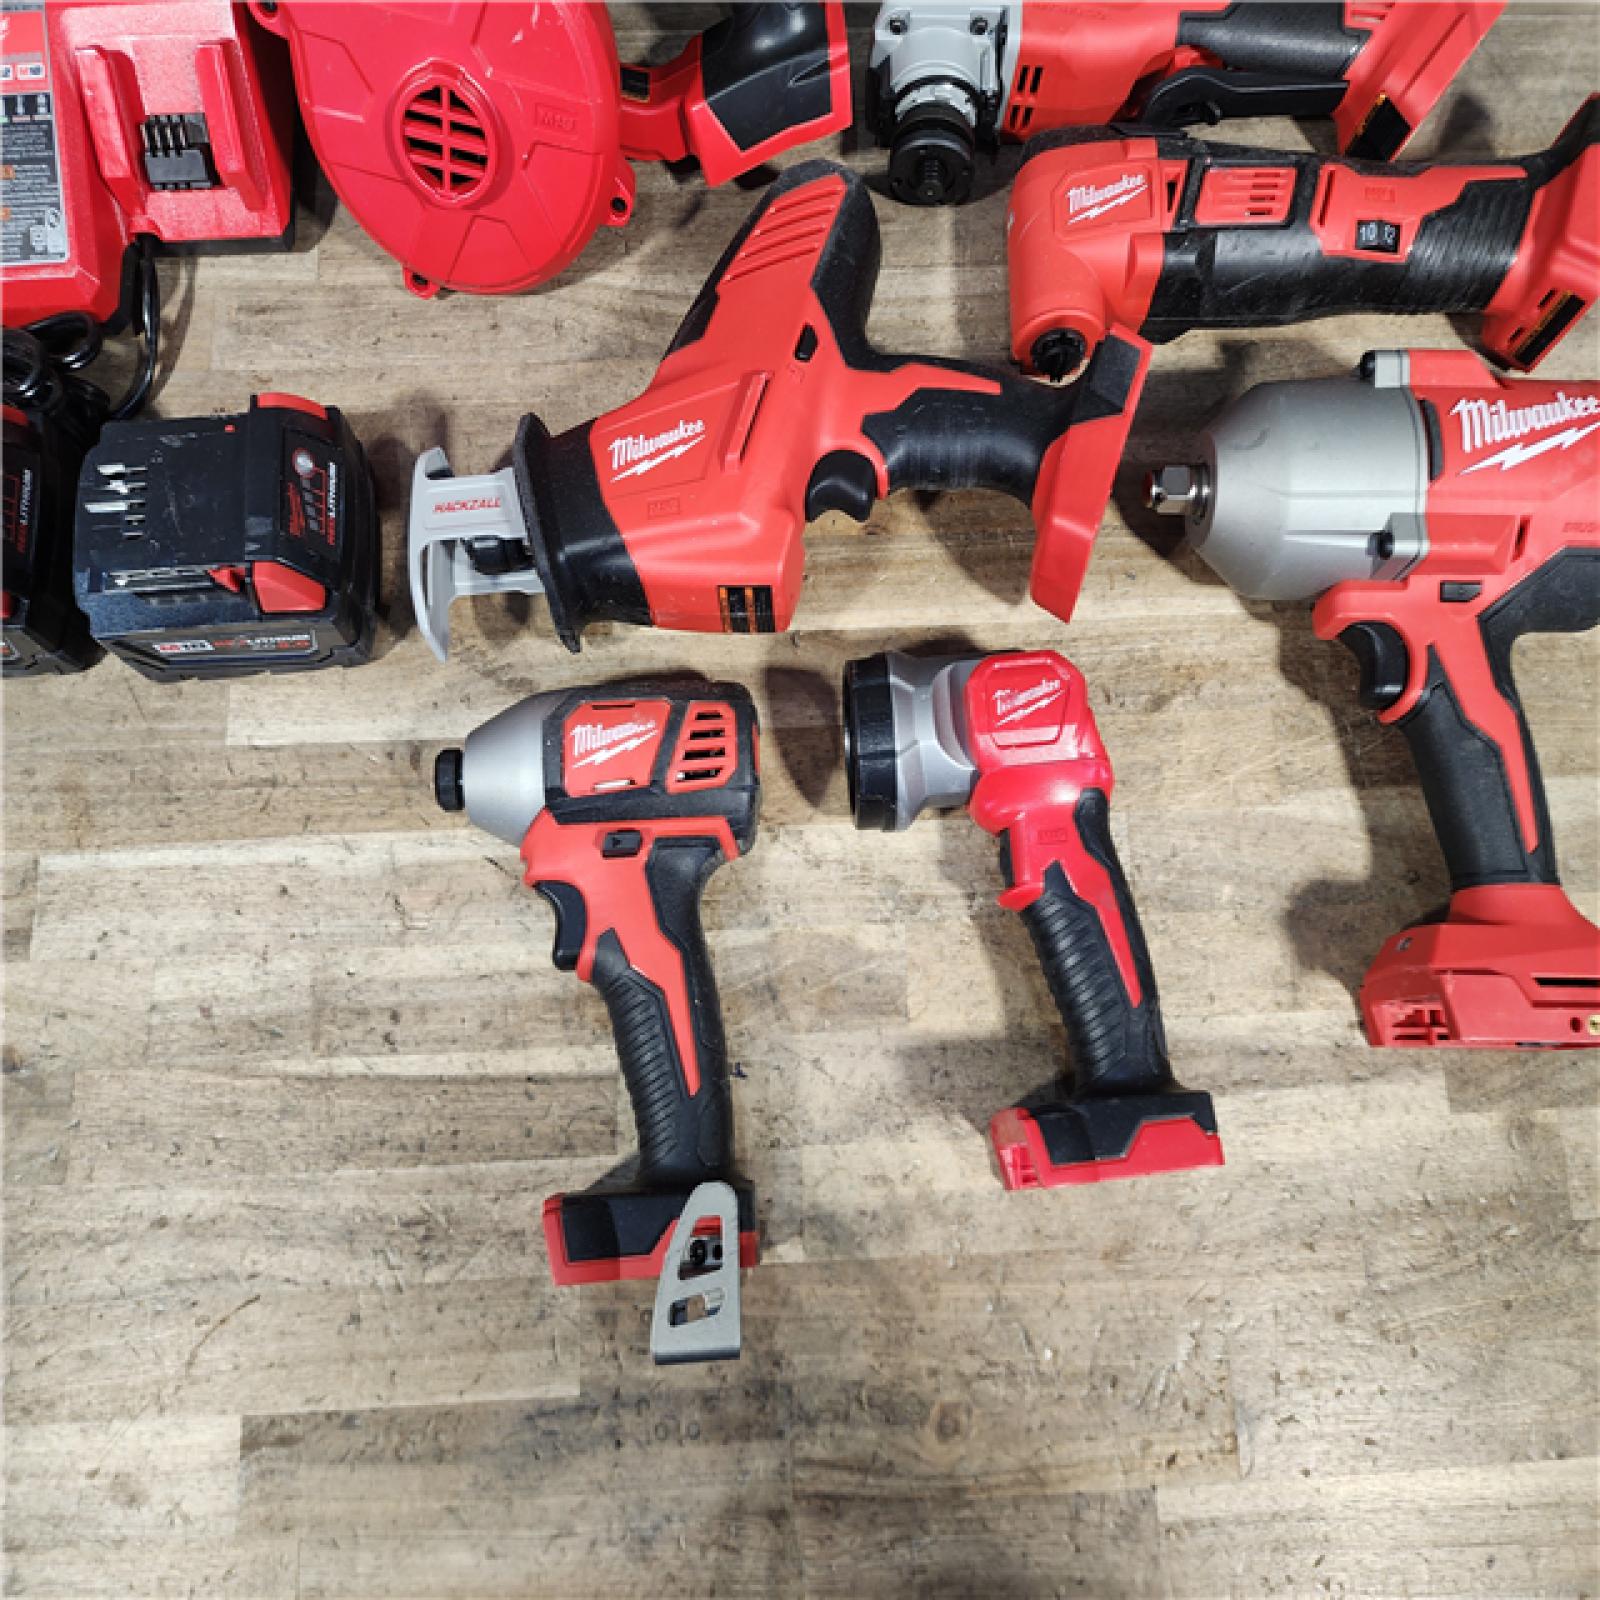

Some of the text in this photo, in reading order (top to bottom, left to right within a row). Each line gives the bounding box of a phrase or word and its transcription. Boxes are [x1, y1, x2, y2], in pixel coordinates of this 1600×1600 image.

[1448, 391, 1600, 453] Milwaukee
[607, 419, 706, 470] Milwaukee
[992, 678, 1061, 716] Mwaukee
[569, 719, 657, 757] Milwau
